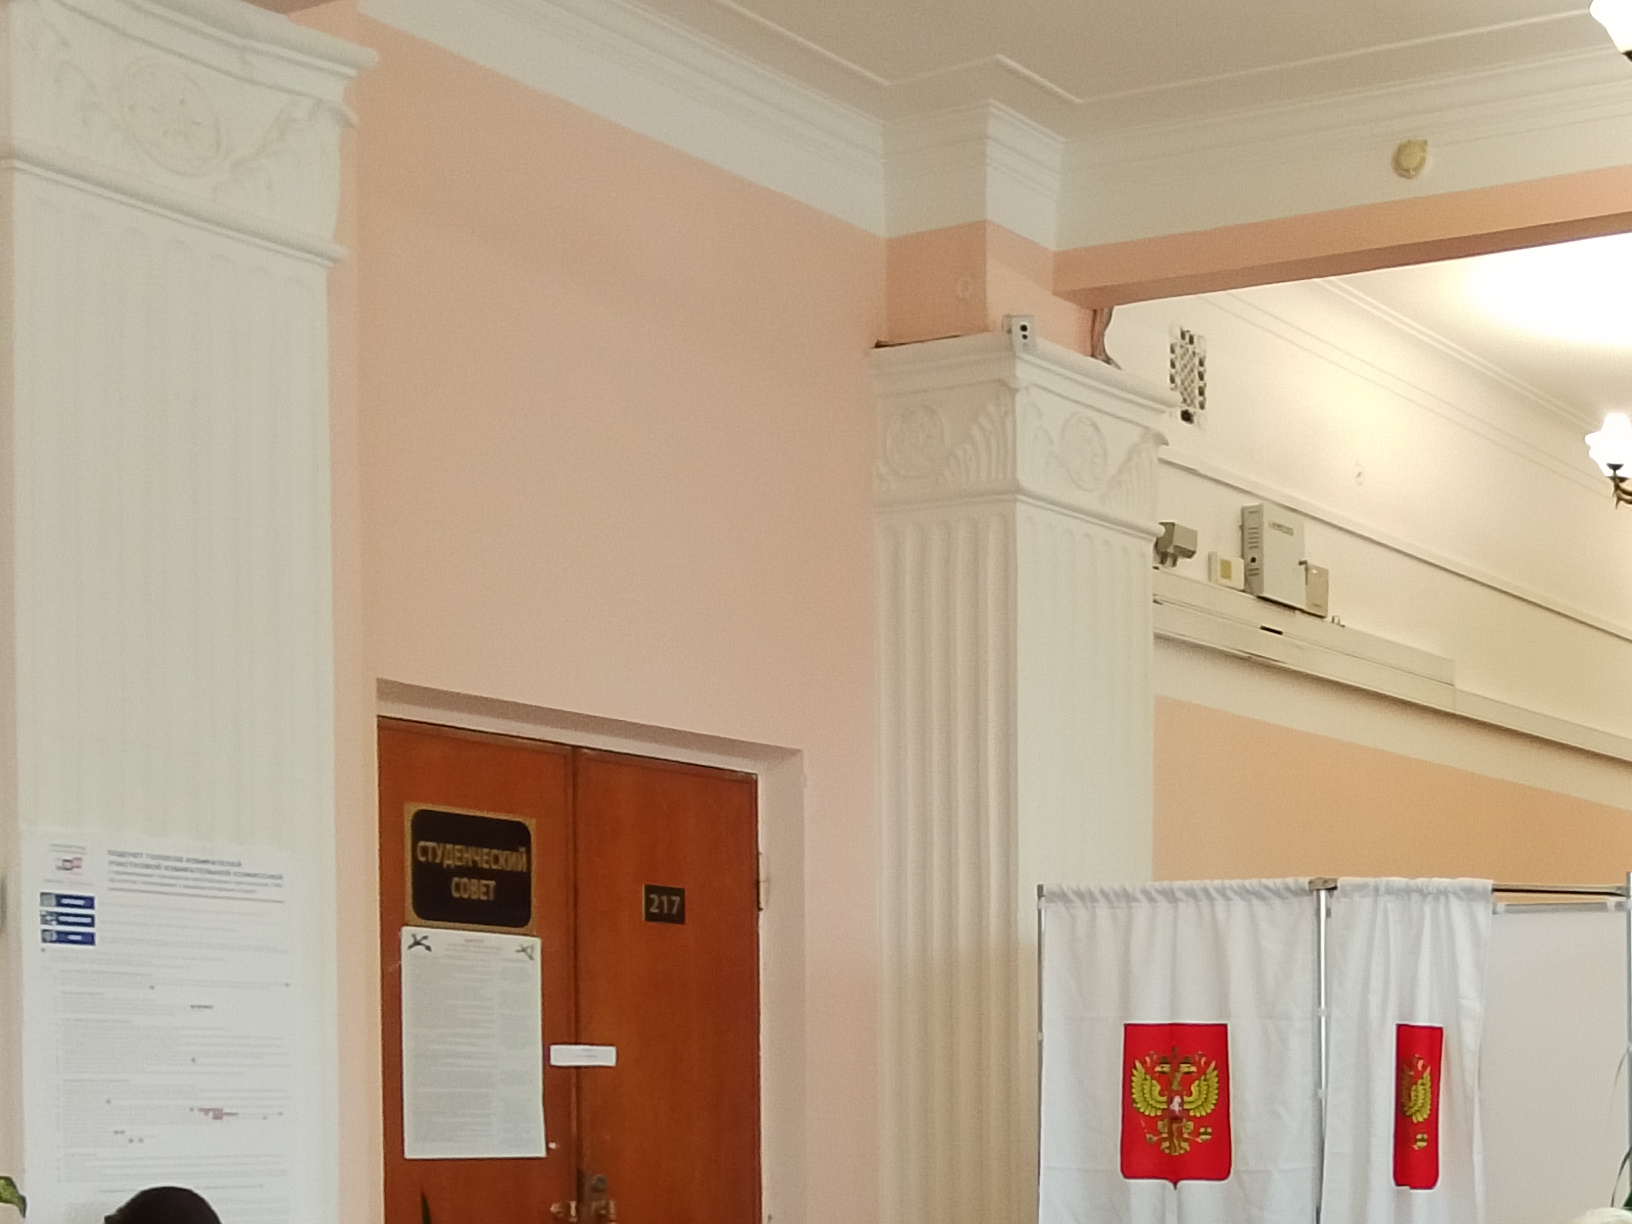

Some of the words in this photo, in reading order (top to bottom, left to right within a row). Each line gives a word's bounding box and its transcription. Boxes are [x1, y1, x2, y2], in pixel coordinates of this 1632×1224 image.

[417, 841, 527, 873] СТУДЕНЧЕСКИЙ
[450, 876, 497, 900] СОВЕТ
[649, 894, 681, 915] 217
